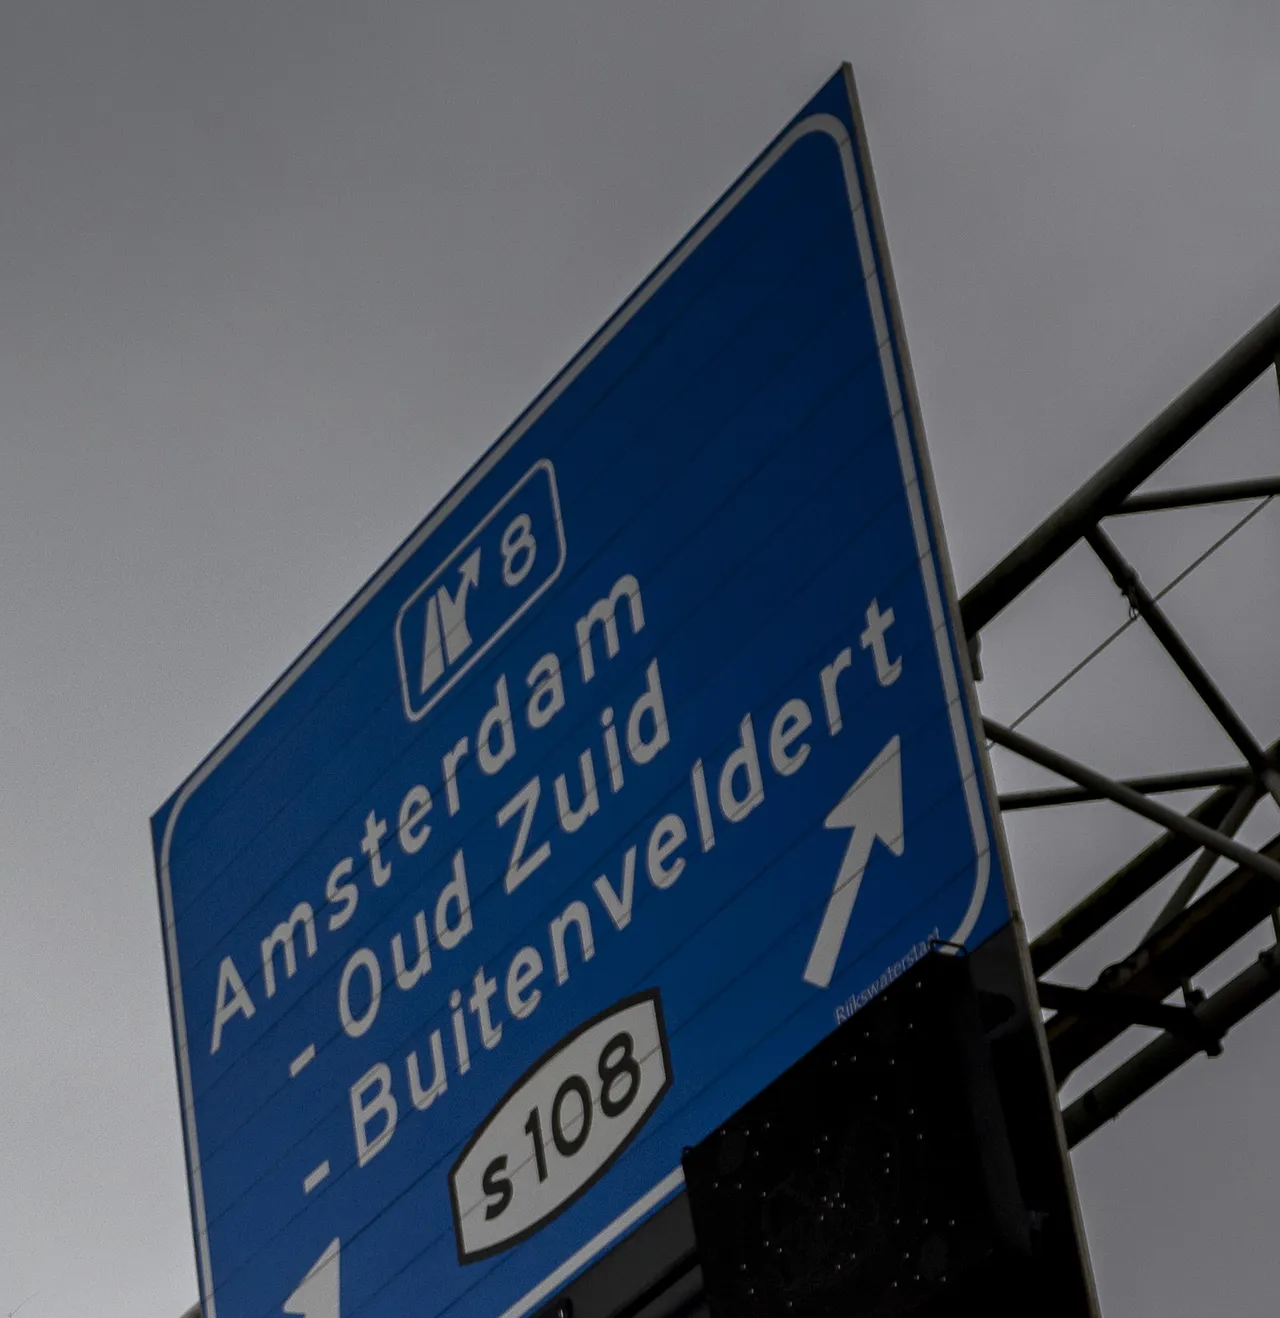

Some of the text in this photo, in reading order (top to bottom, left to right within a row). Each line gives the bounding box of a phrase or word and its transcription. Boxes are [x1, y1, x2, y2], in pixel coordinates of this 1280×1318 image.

[500, 513, 537, 588] 8
[210, 572, 646, 1056] Amsterdam
[338, 848, 474, 1039] Oud
[495, 656, 671, 896] Zuid
[348, 596, 904, 1168] Buitenveldert
